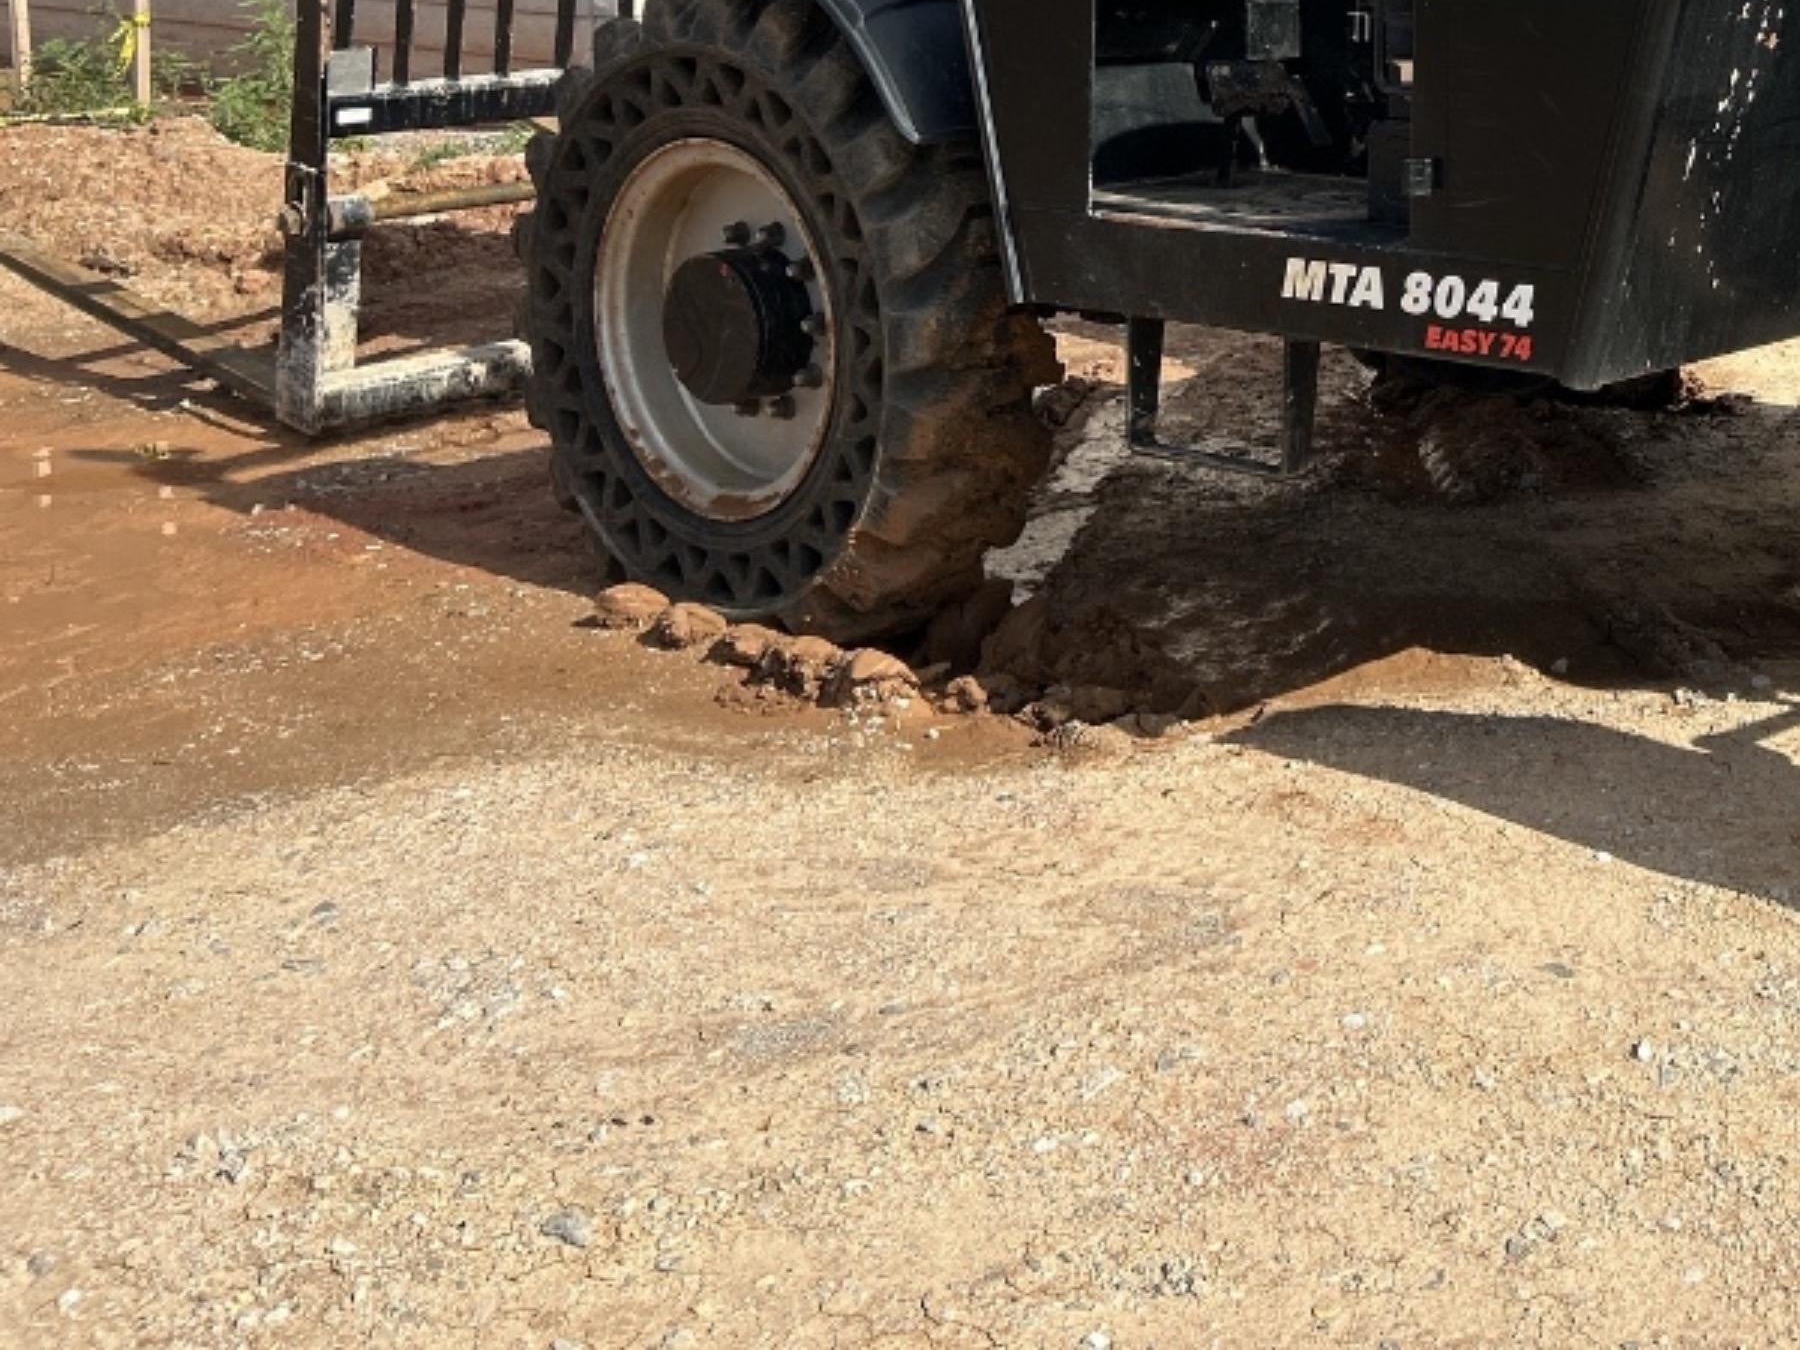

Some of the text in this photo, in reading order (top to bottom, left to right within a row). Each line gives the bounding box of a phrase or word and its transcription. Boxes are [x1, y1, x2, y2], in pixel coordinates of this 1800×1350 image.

[1281, 257, 1534, 327] MTA 8044
[1425, 324, 1532, 360] EASY 74
